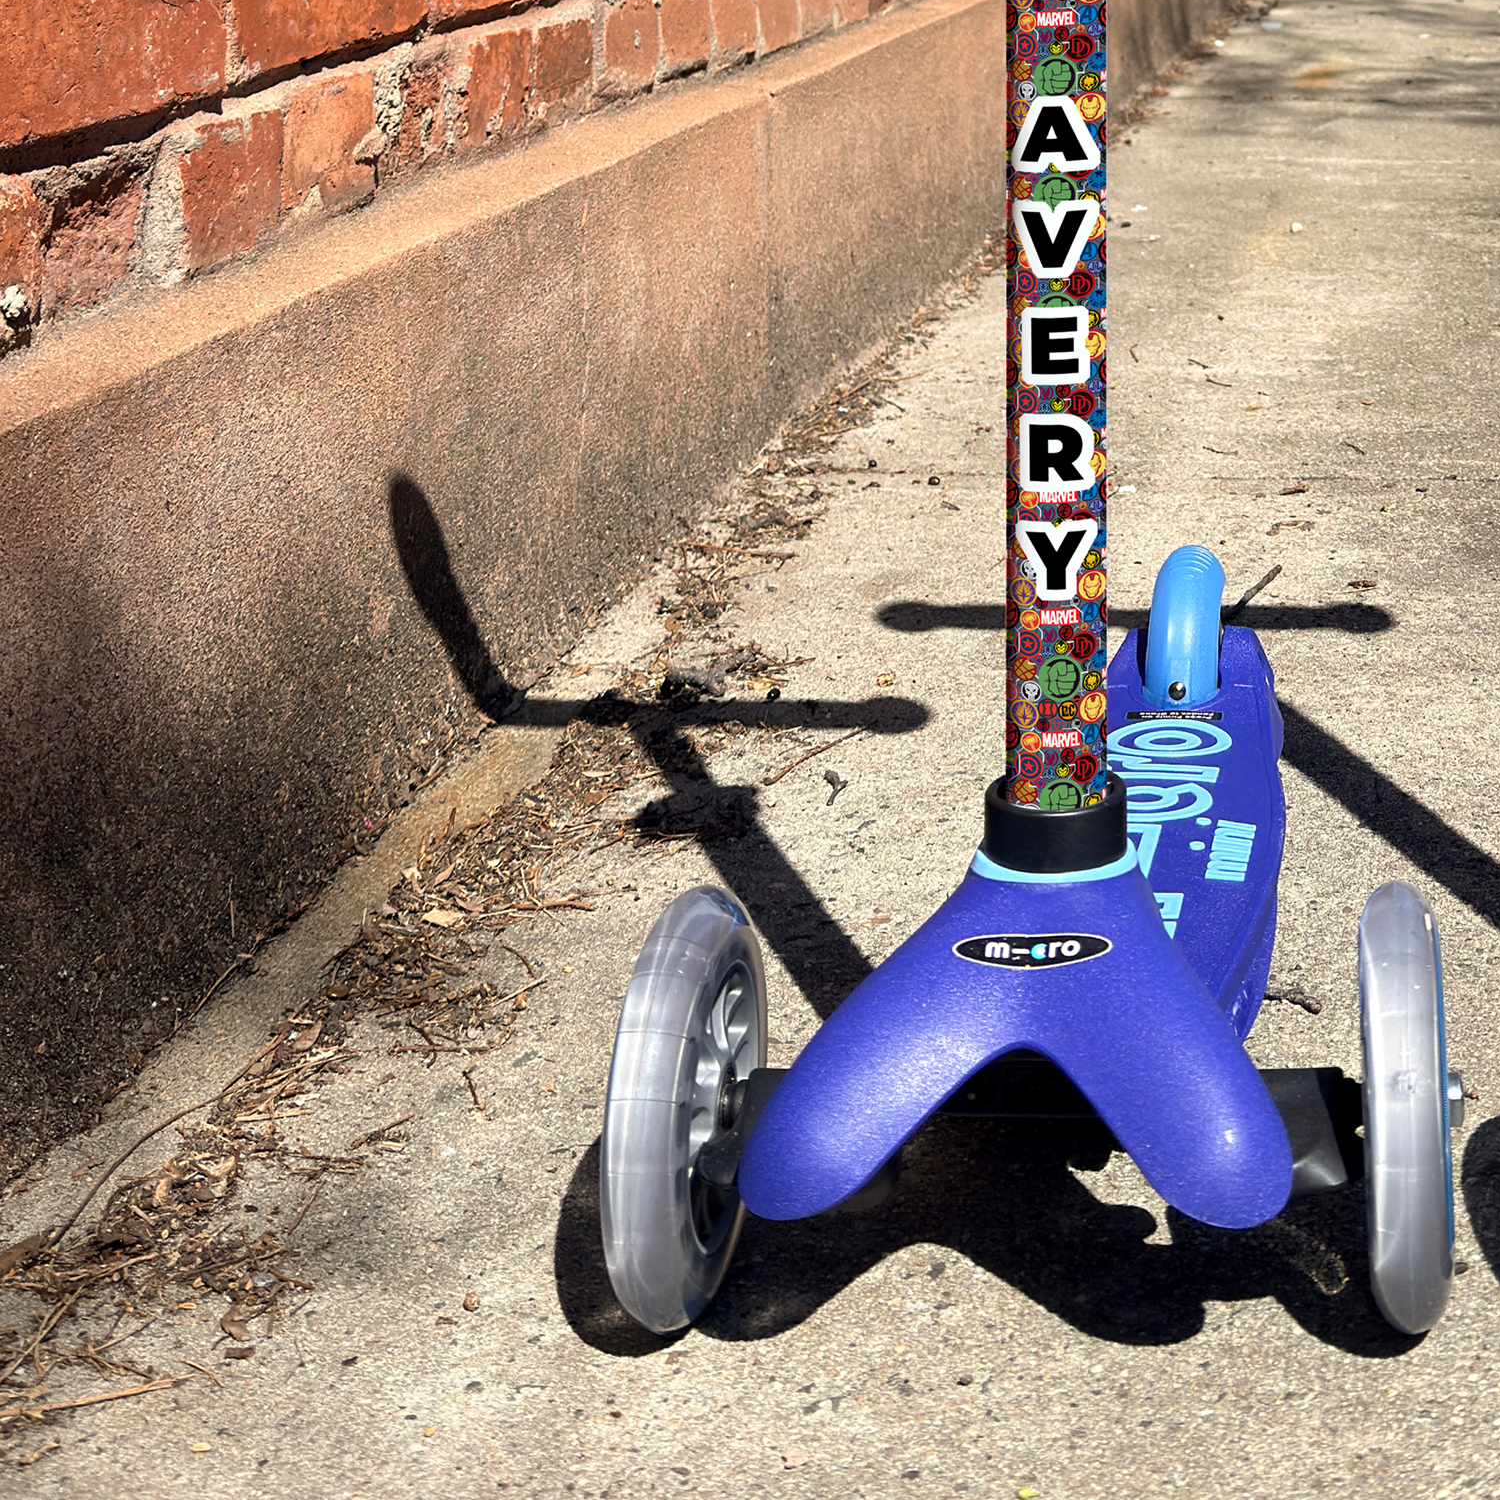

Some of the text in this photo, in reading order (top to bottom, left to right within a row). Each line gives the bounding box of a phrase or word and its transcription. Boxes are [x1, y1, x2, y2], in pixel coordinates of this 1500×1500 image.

[1037, 11, 1075, 26] MARVEL
[1020, 105, 1089, 591] AVERY
[1041, 609, 1079, 624] MARVEL
[1041, 732, 1080, 748] MARVEL
[1189, 817, 1257, 882] mini
